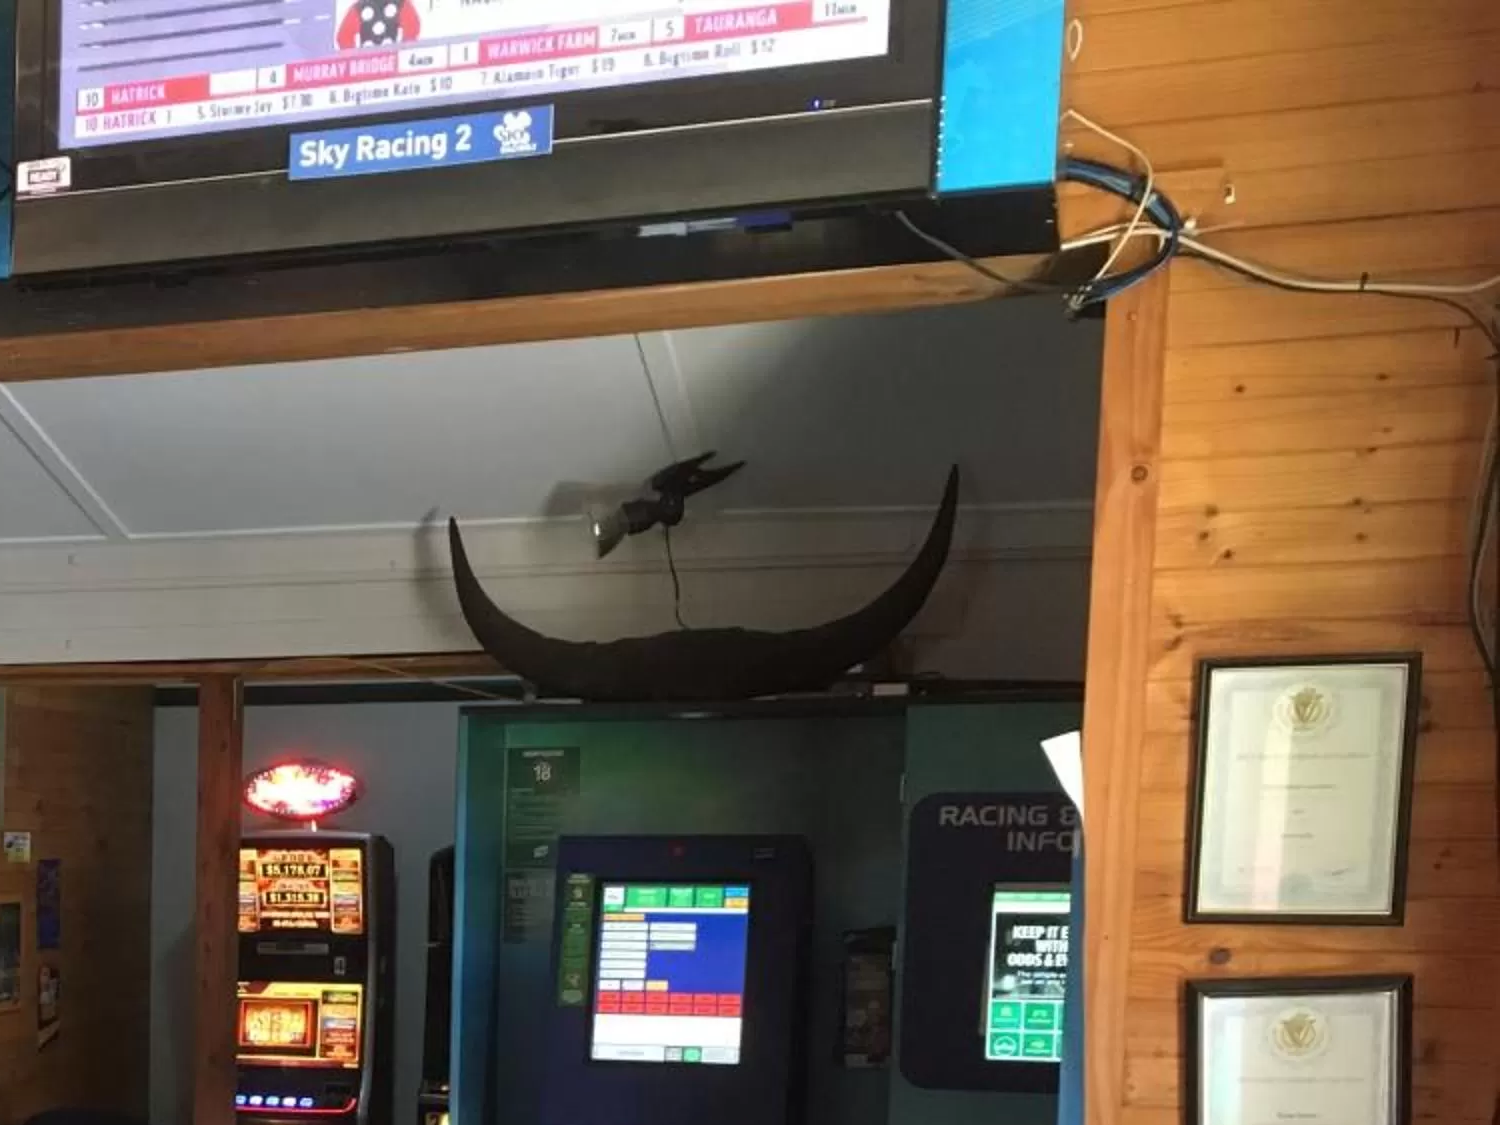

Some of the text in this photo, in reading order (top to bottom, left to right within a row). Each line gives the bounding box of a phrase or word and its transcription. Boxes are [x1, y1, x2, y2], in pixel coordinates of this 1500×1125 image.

[694, 8, 778, 33] TAURANGA
[487, 36, 554, 58] WARWICK
[557, 31, 596, 50] FARM
[293, 62, 348, 83] MURRAY
[350, 55, 396, 76] BRIDGE
[86, 83, 166, 107] 10 HATRICK
[102, 110, 157, 130] HATRICK
[299, 123, 473, 170] Sky Racing 2
[938, 804, 1049, 827] RACING
[1007, 830, 1075, 852] INFO
[1012, 925, 1045, 940] KEEP
